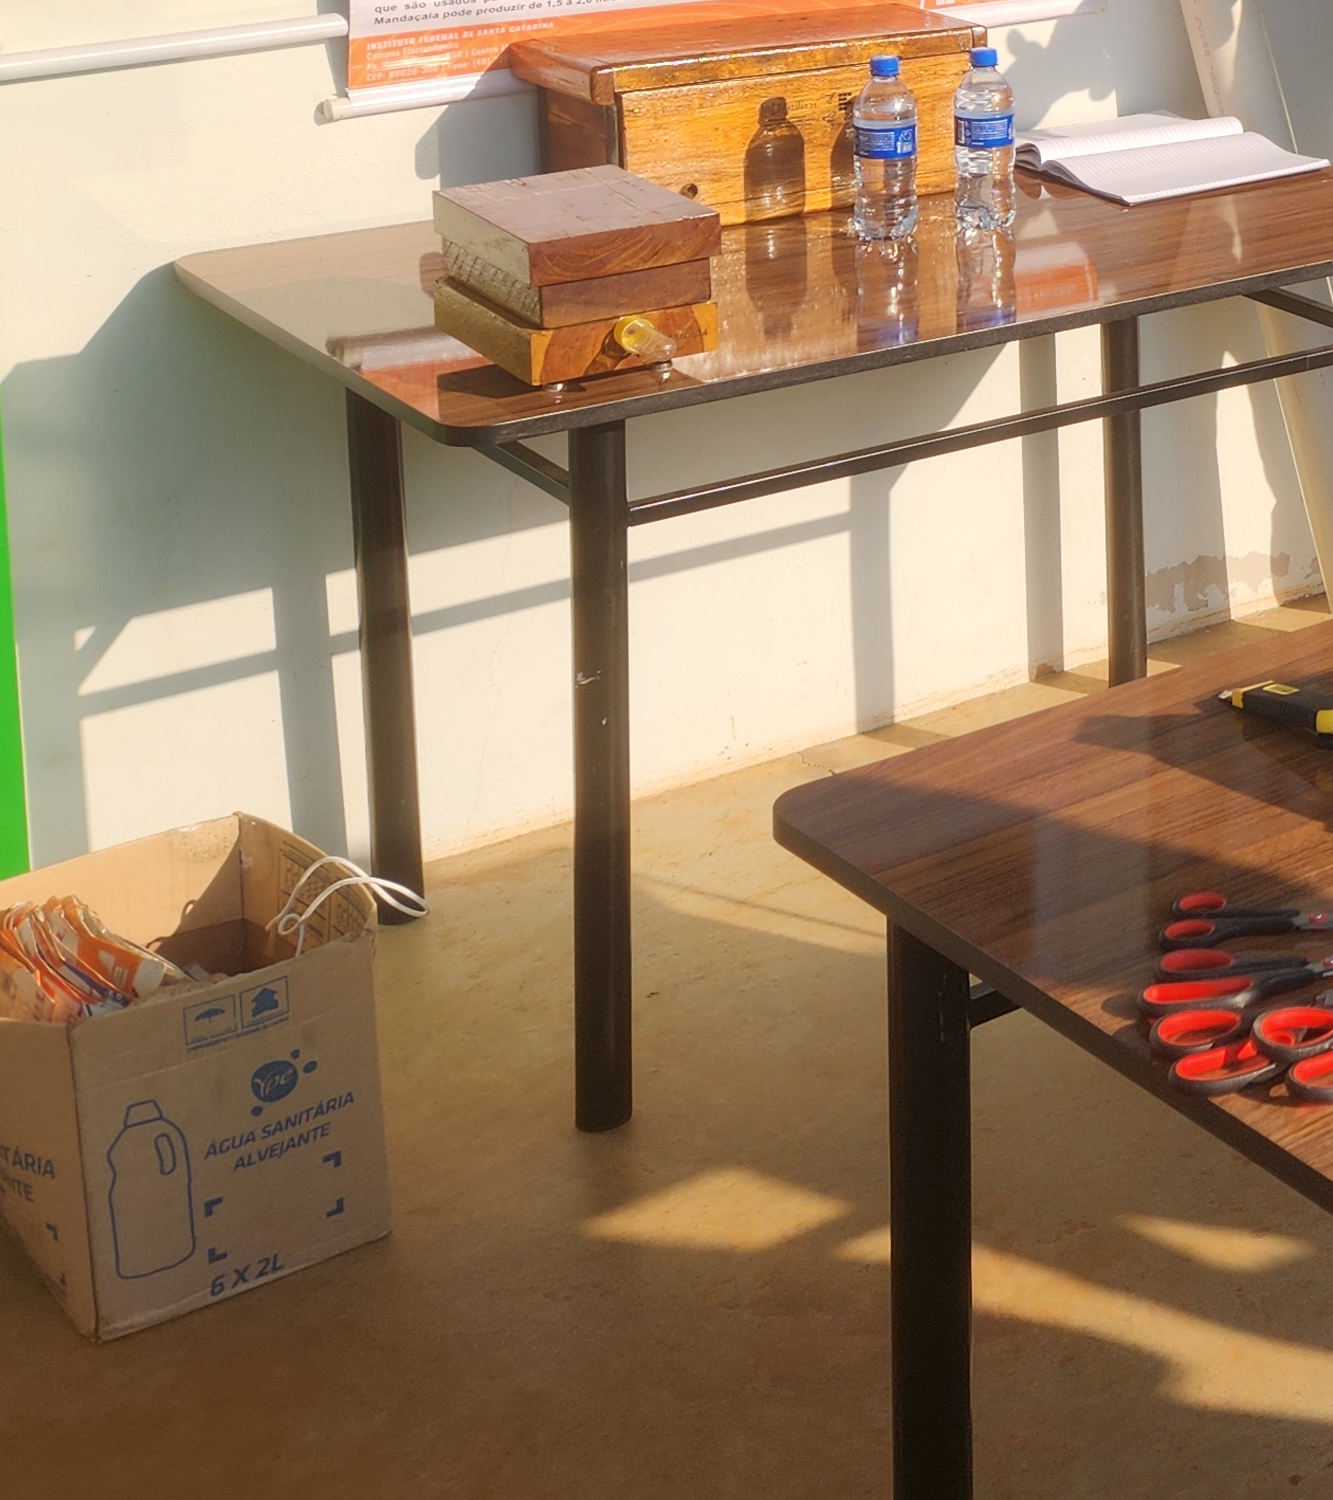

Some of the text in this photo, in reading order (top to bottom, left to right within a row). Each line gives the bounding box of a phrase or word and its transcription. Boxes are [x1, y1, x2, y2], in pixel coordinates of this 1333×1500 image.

[374, 10, 439, 24] Mandaçaia
[442, 8, 472, 19] pode
[475, 2, 525, 16] produzir
[528, 1, 542, 9] de
[367, 22, 554, 50] INSTITUTO FEDERAL DE SANTA CATARINA
[204, 1092, 355, 1160] ÁGUA SANITÁRIA
[232, 1122, 332, 1172] ALVEJANTE
[210, 1253, 284, 1296] 6 X 2L
